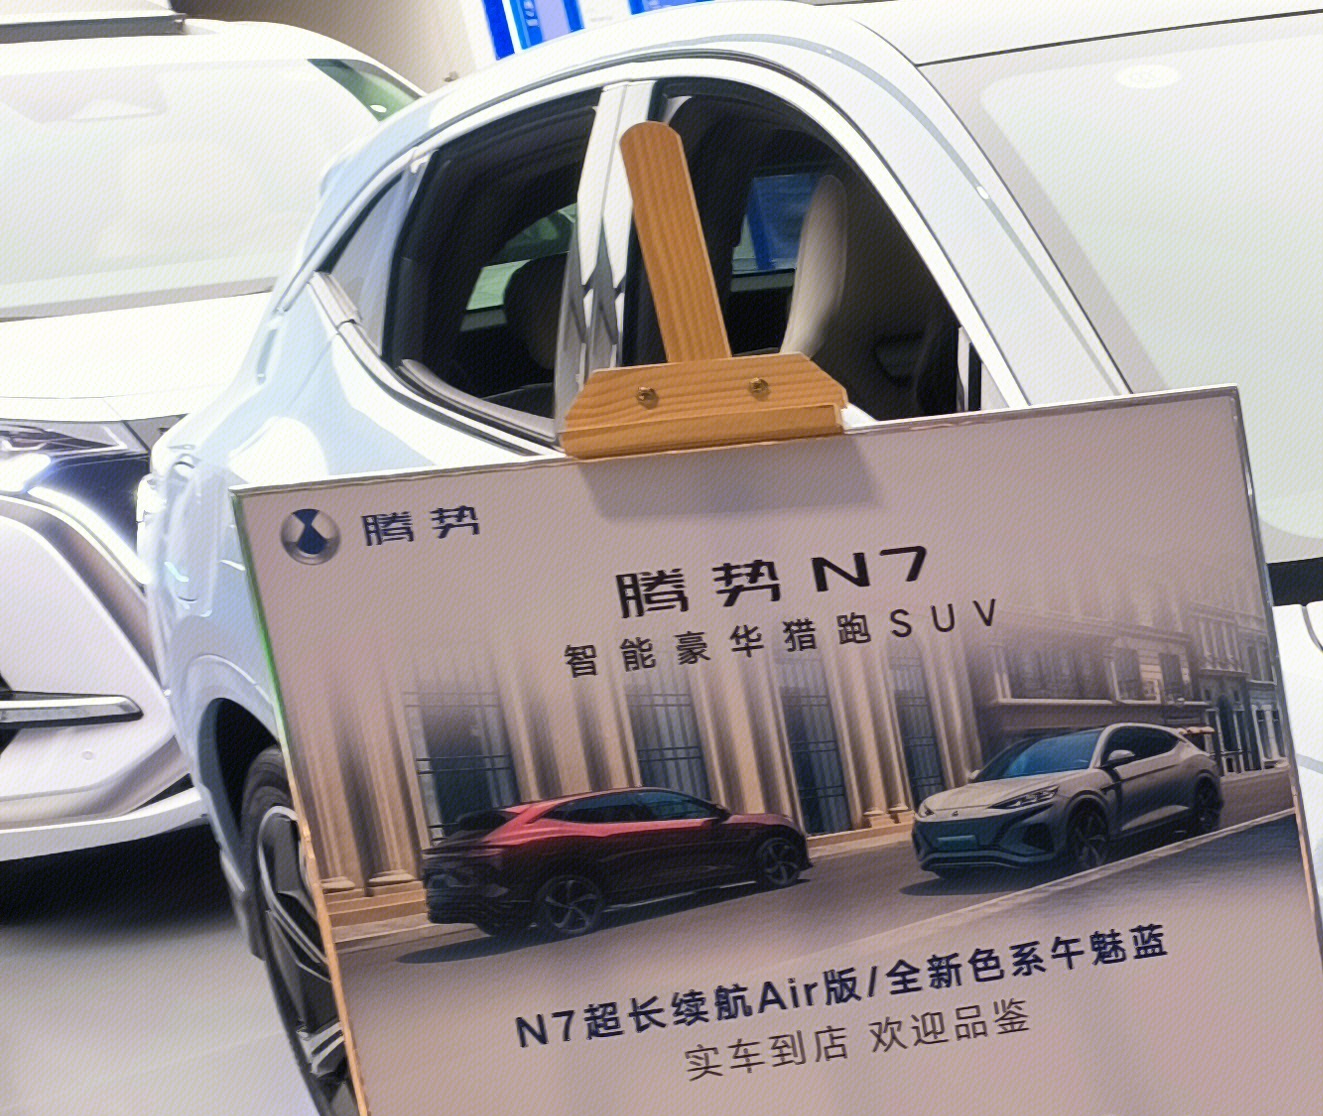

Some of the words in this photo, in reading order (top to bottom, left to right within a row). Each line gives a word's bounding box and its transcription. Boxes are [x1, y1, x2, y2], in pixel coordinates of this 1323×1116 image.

[361, 505, 480, 546] 腾势
[515, 923, 1168, 1049] N7超长续航Air版/全新色系午魅蓝
[684, 1026, 850, 1082] 实车到店
[868, 998, 1031, 1054] 欢迎品鉴
